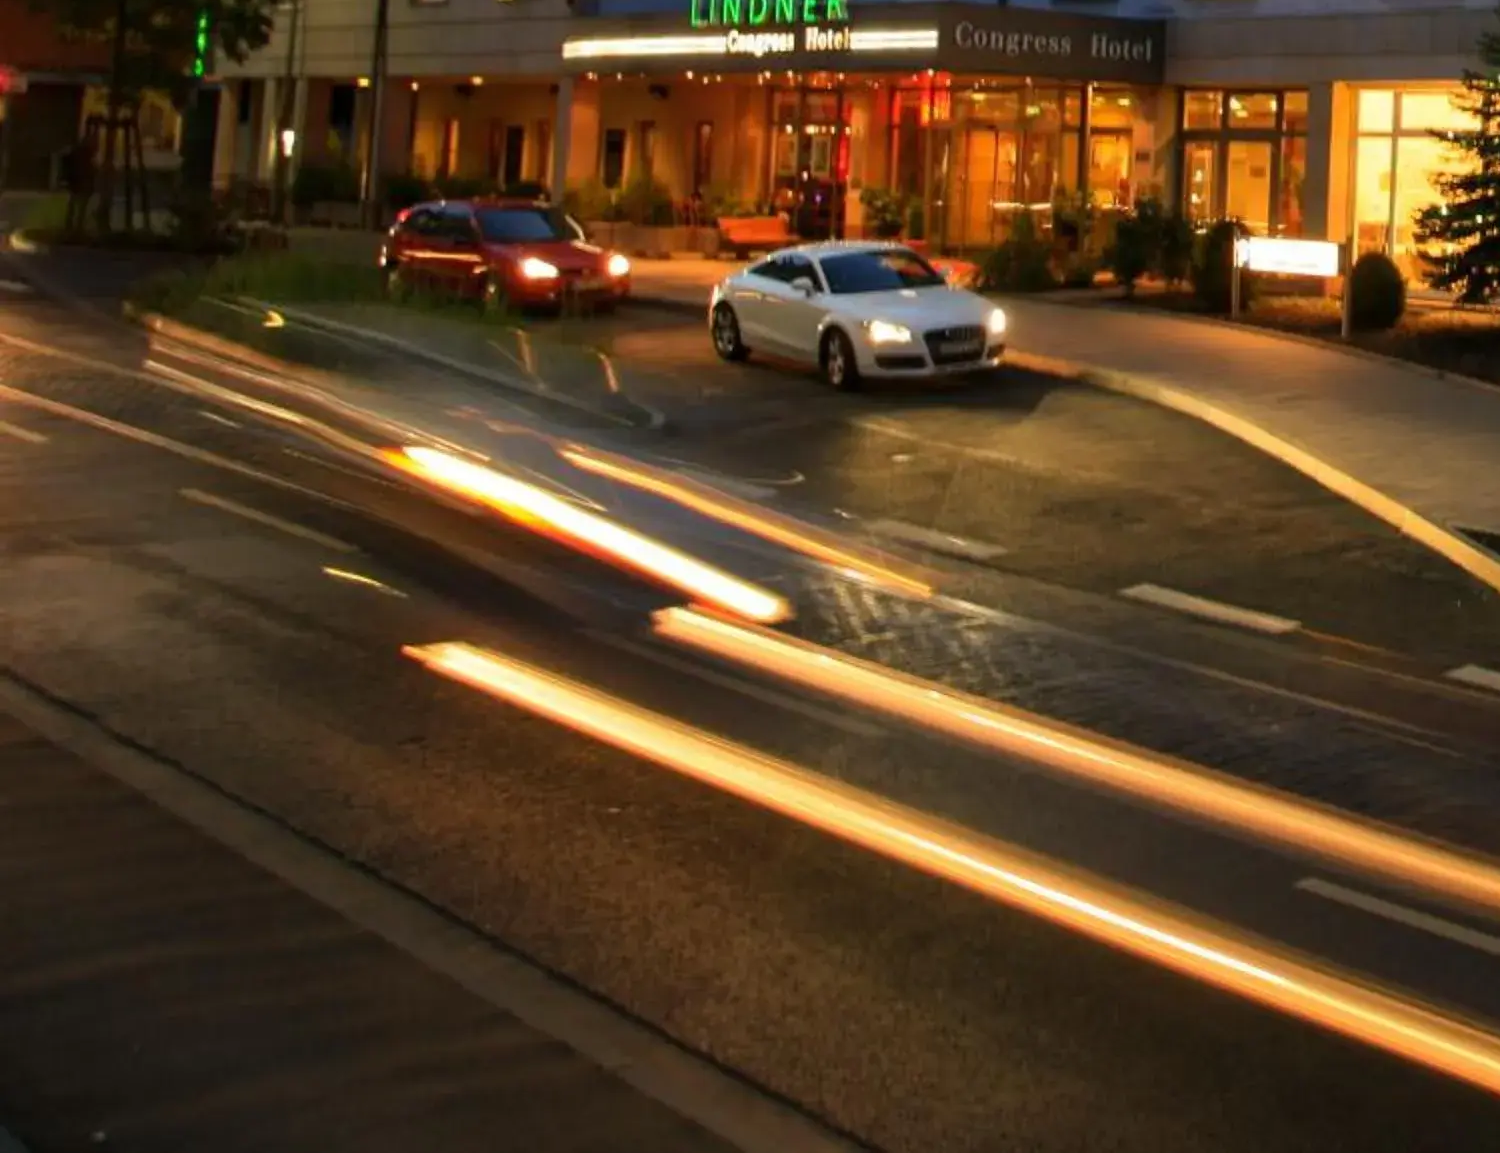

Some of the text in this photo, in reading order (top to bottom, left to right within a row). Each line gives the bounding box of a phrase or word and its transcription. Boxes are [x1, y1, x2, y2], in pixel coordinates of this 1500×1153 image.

[727, 25, 850, 58] Congress Hotel
[955, 20, 1154, 64] Congress Hotel
